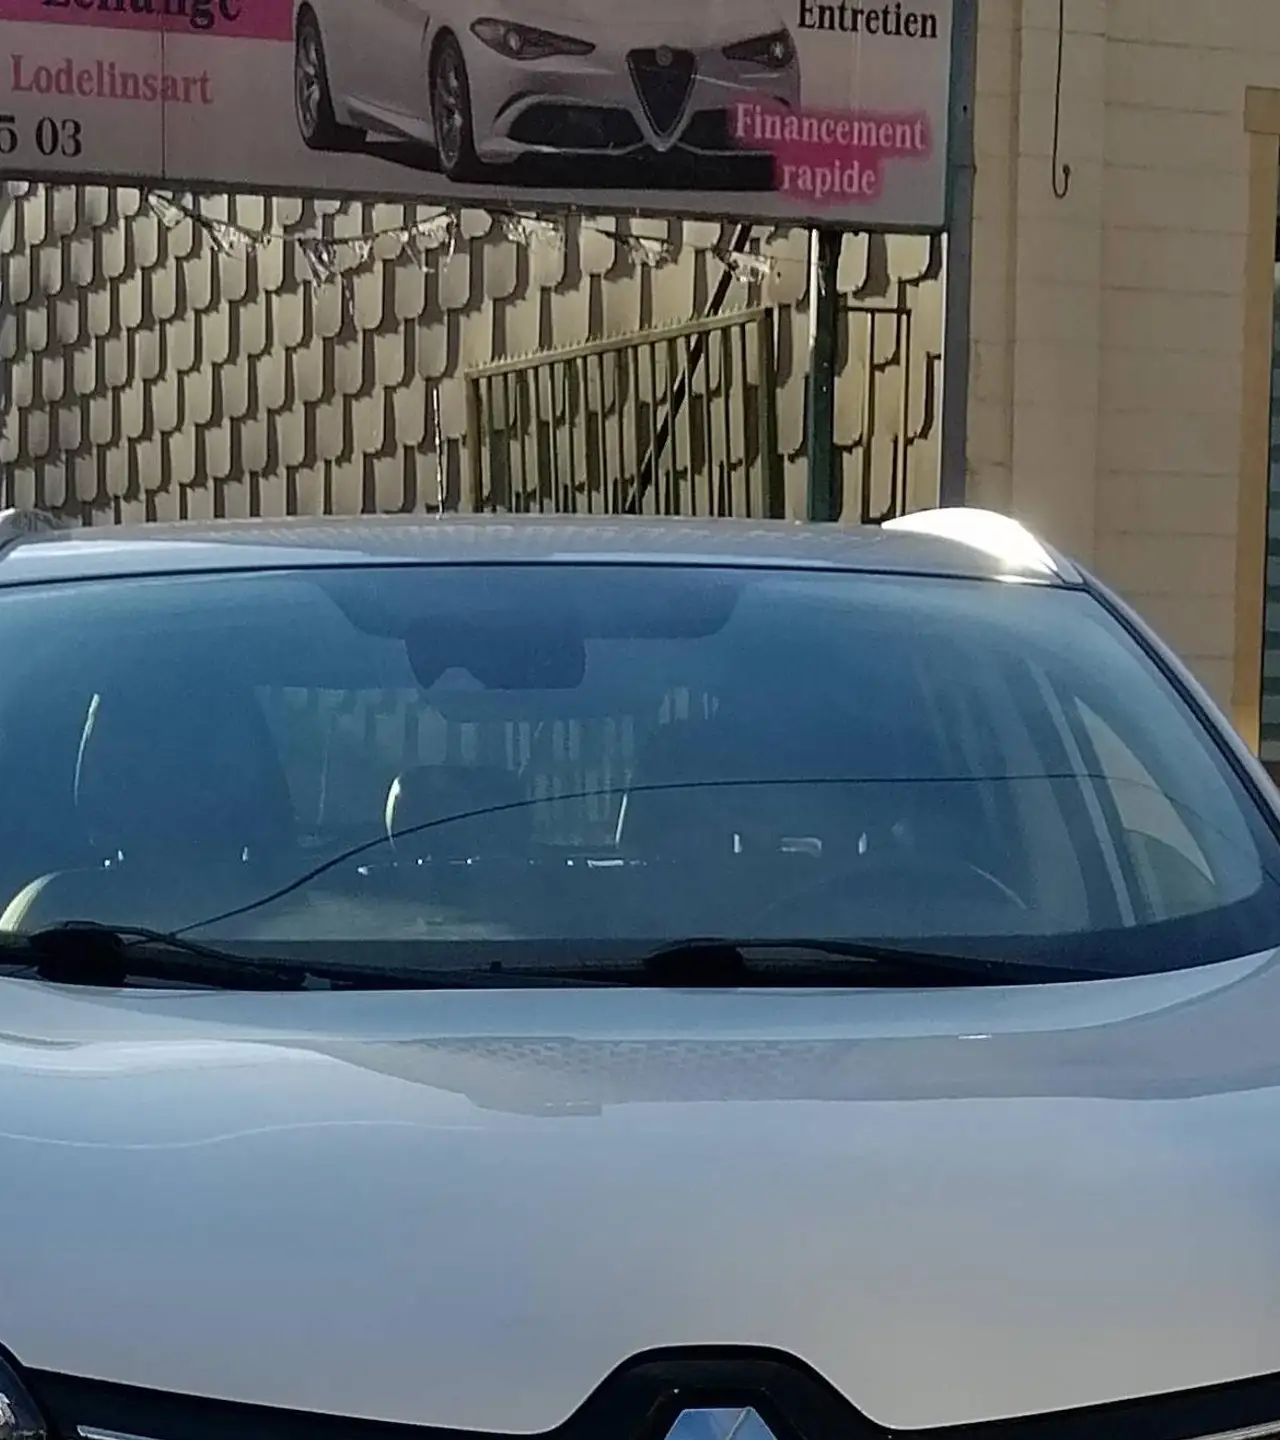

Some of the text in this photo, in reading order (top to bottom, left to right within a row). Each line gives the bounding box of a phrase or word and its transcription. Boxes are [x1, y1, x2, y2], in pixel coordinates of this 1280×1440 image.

[798, 0, 937, 38] Entretien
[11, 56, 213, 105] Lodelinsart
[35, 114, 82, 158] 03
[734, 103, 926, 151] Financement
[781, 160, 876, 198] rapide
